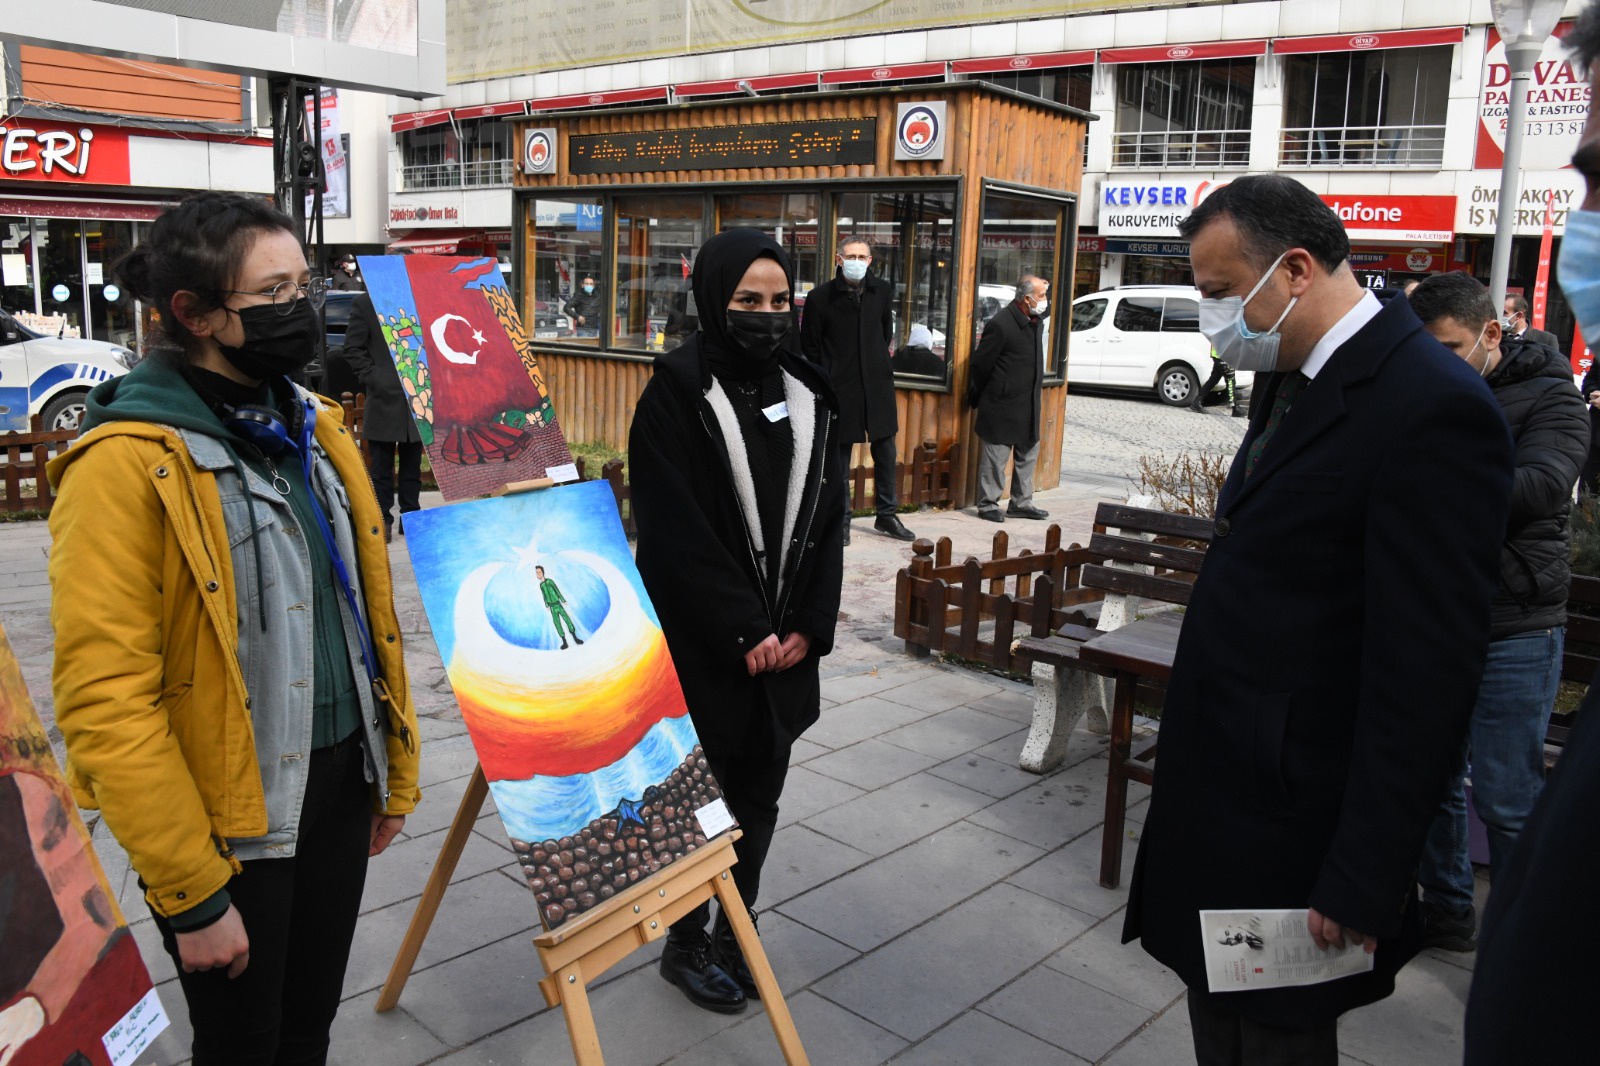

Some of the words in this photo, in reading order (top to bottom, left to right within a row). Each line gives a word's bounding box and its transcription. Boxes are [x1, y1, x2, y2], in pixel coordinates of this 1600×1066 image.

[1486, 60, 1590, 88] DVA
[1484, 87, 1592, 105] PATANES
[1528, 106, 1537, 116] &
[1548, 122, 1564, 136] 13
[1105, 186, 1187, 206] KEVSER
[1471, 185, 1501, 203] ÖM
[1469, 205, 1485, 227] İŞ
[1127, 243, 1158, 252] KEVSER
[1162, 244, 1190, 254] KURUY
[1347, 254, 1384, 262] SAMSUNG
